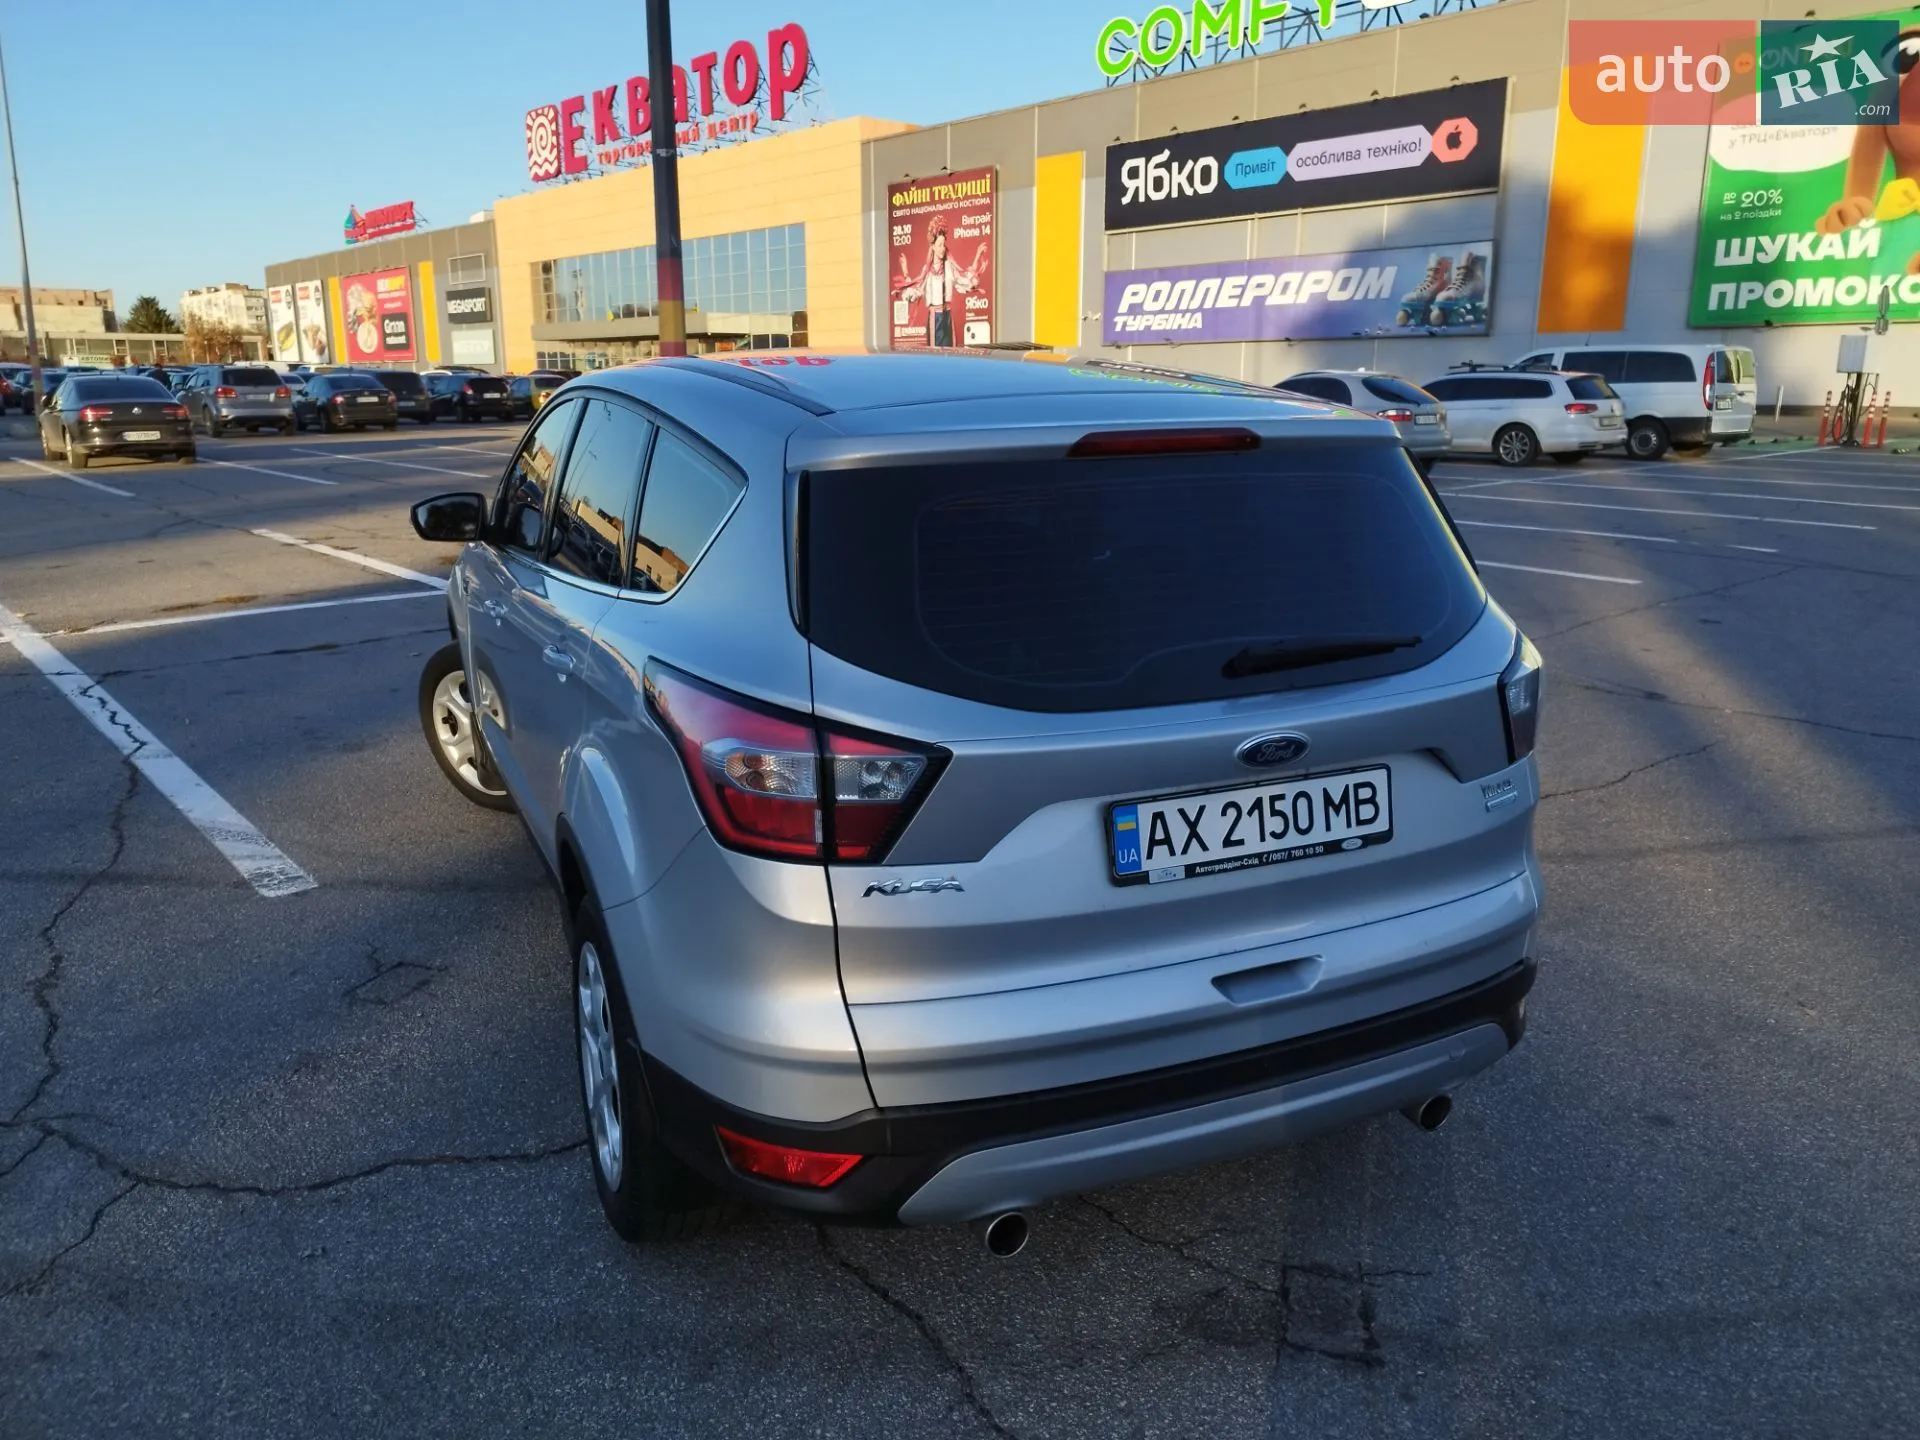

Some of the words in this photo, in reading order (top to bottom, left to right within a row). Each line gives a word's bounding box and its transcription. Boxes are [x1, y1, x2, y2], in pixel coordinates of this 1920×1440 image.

[707, 111, 759, 140] центр
[1235, 159, 1277, 179] Привіт
[1296, 149, 1361, 169] особлива
[1367, 137, 1423, 159] техніко!
[1121, 149, 1219, 205] Ябко
[892, 186, 930, 207] ФАЙНІ
[932, 174, 991, 200] ТРАДИЦІЇ
[1741, 188, 1783, 207] 20%
[961, 212, 992, 226] Виграй
[893, 224, 912, 235] 28.10
[953, 227, 980, 239] iPhone
[981, 225, 991, 236] 14
[893, 235, 911, 246] 12:00
[1714, 218, 1881, 267] ШУКАЙ
[1117, 265, 1398, 314] РОЛЛЕРДРОМ
[1113, 312, 1203, 332] ТУРБІНА
[1257, 741, 1296, 761] Ford
[1146, 804, 1210, 860] AX
[1220, 790, 1315, 850] 2150
[1322, 781, 1381, 833] MB
[1118, 848, 1139, 864] UA
